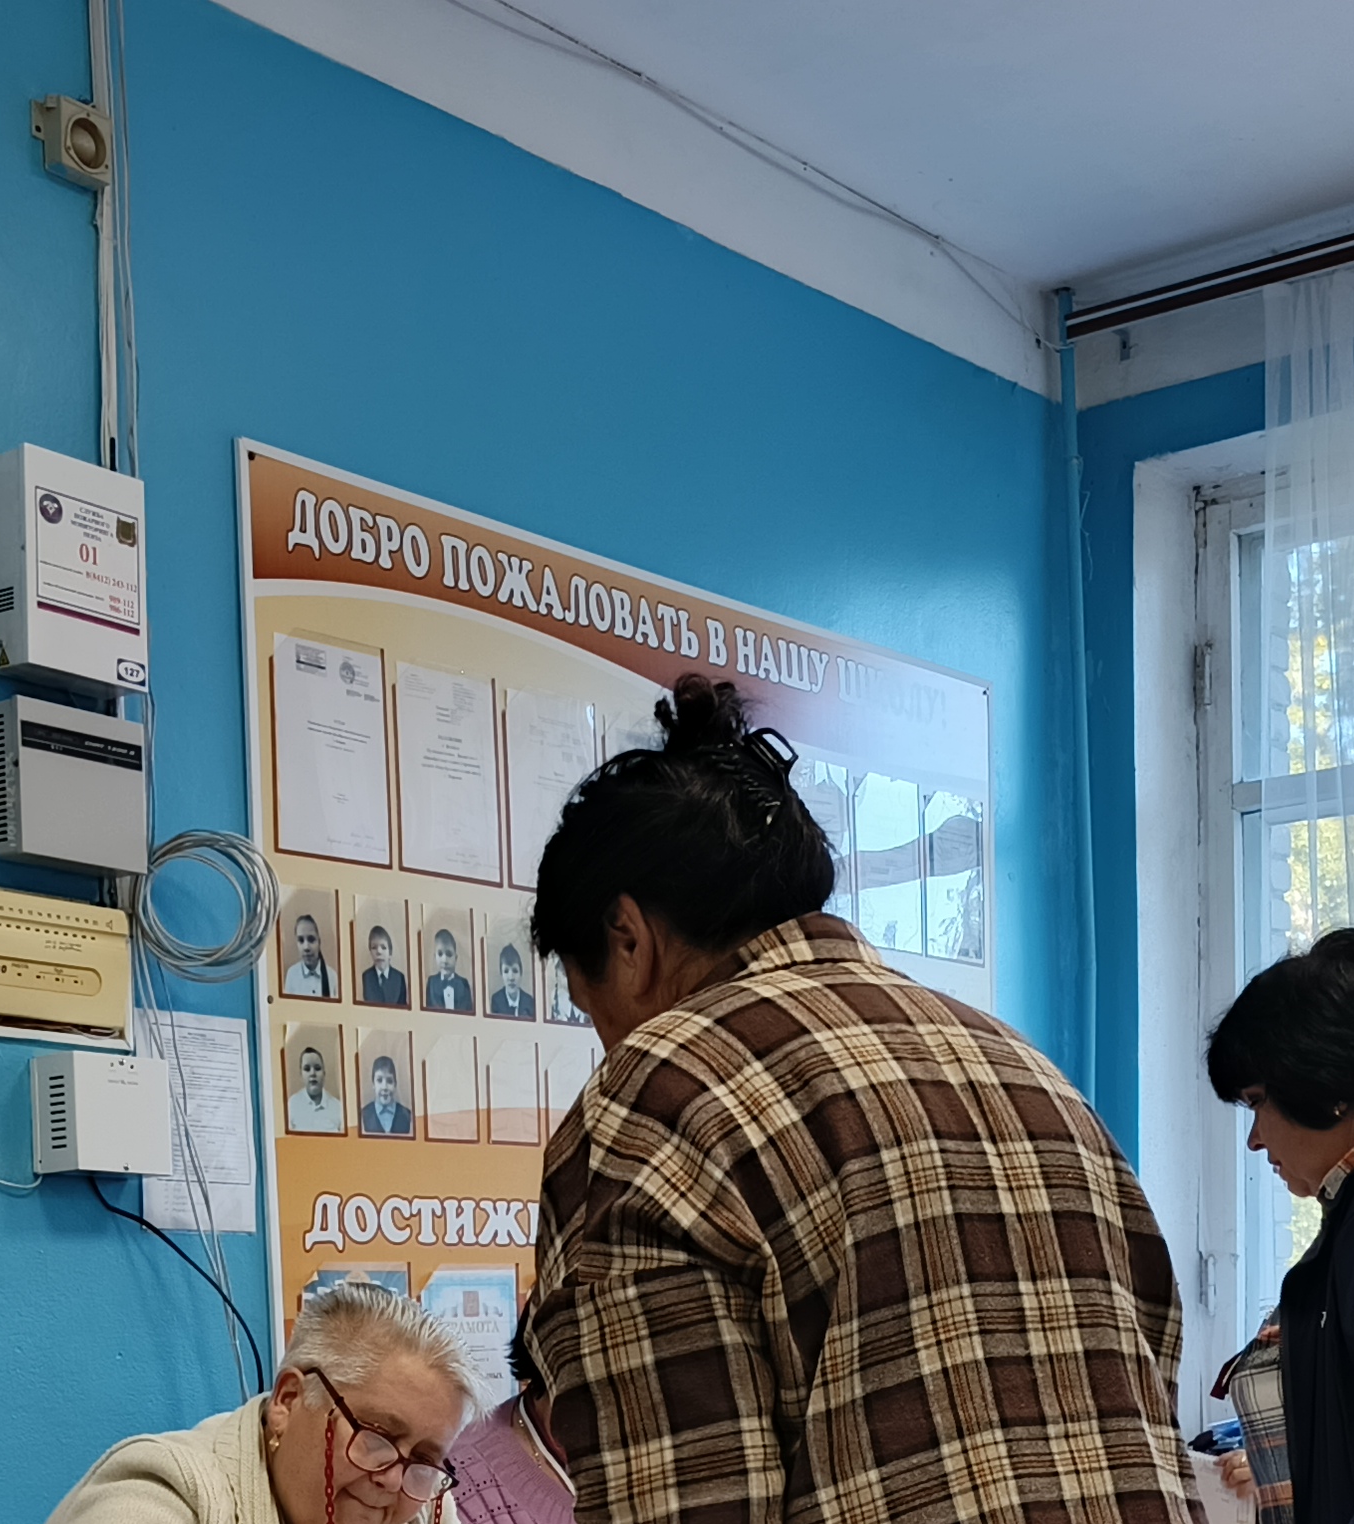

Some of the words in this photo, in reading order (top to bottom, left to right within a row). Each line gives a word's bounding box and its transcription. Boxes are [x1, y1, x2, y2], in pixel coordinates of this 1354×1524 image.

[79, 543, 98, 566] 01
[287, 488, 430, 578] ДОБРО
[440, 532, 700, 659] ПОЖАЛОВАТЬ
[705, 615, 728, 667] В
[734, 626, 829, 694] НАШУ
[124, 666, 140, 678] 127
[445, 1320, 500, 1334] РАМОТА
